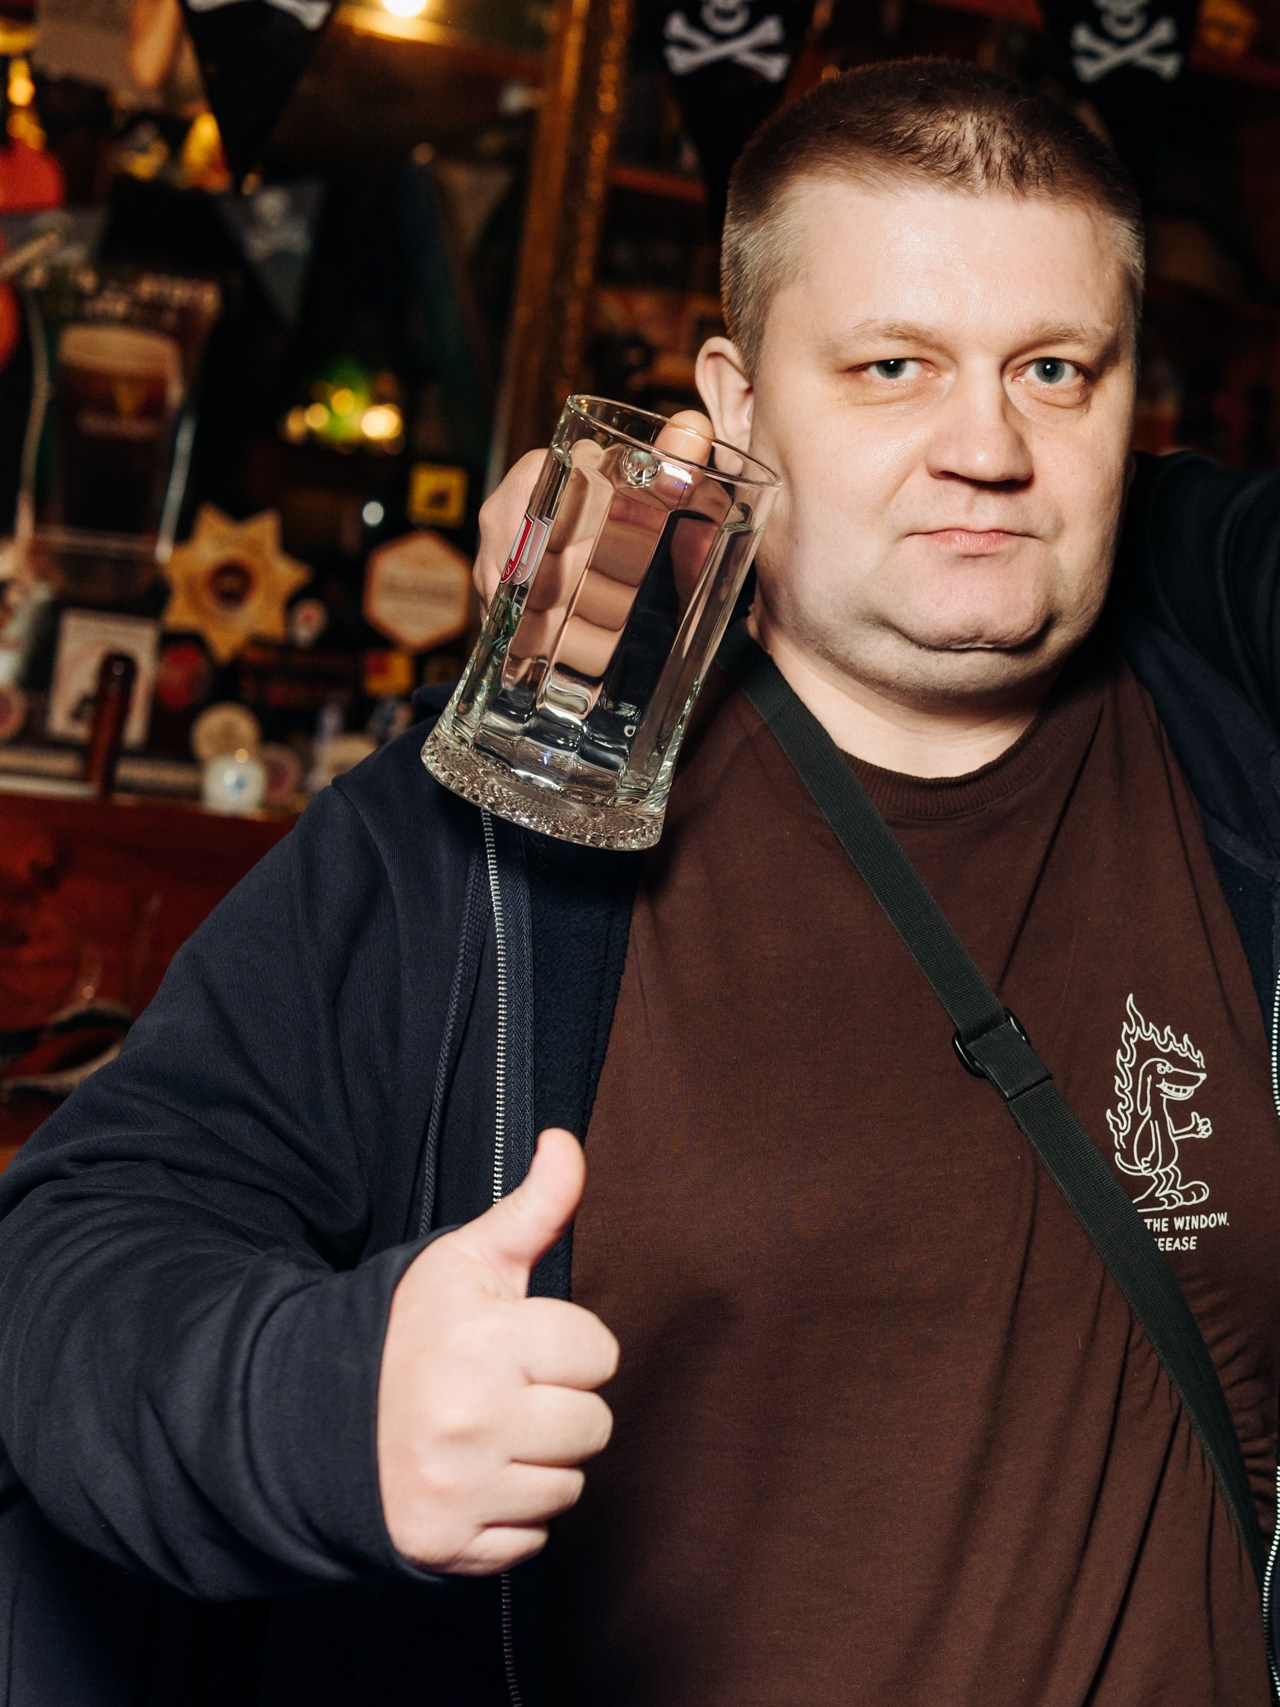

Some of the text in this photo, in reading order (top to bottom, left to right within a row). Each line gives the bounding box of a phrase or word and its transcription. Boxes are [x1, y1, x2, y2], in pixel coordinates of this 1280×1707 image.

[1143, 1211, 1230, 1232] THE WINDOW.
[1154, 1235, 1198, 1252] EEASE
